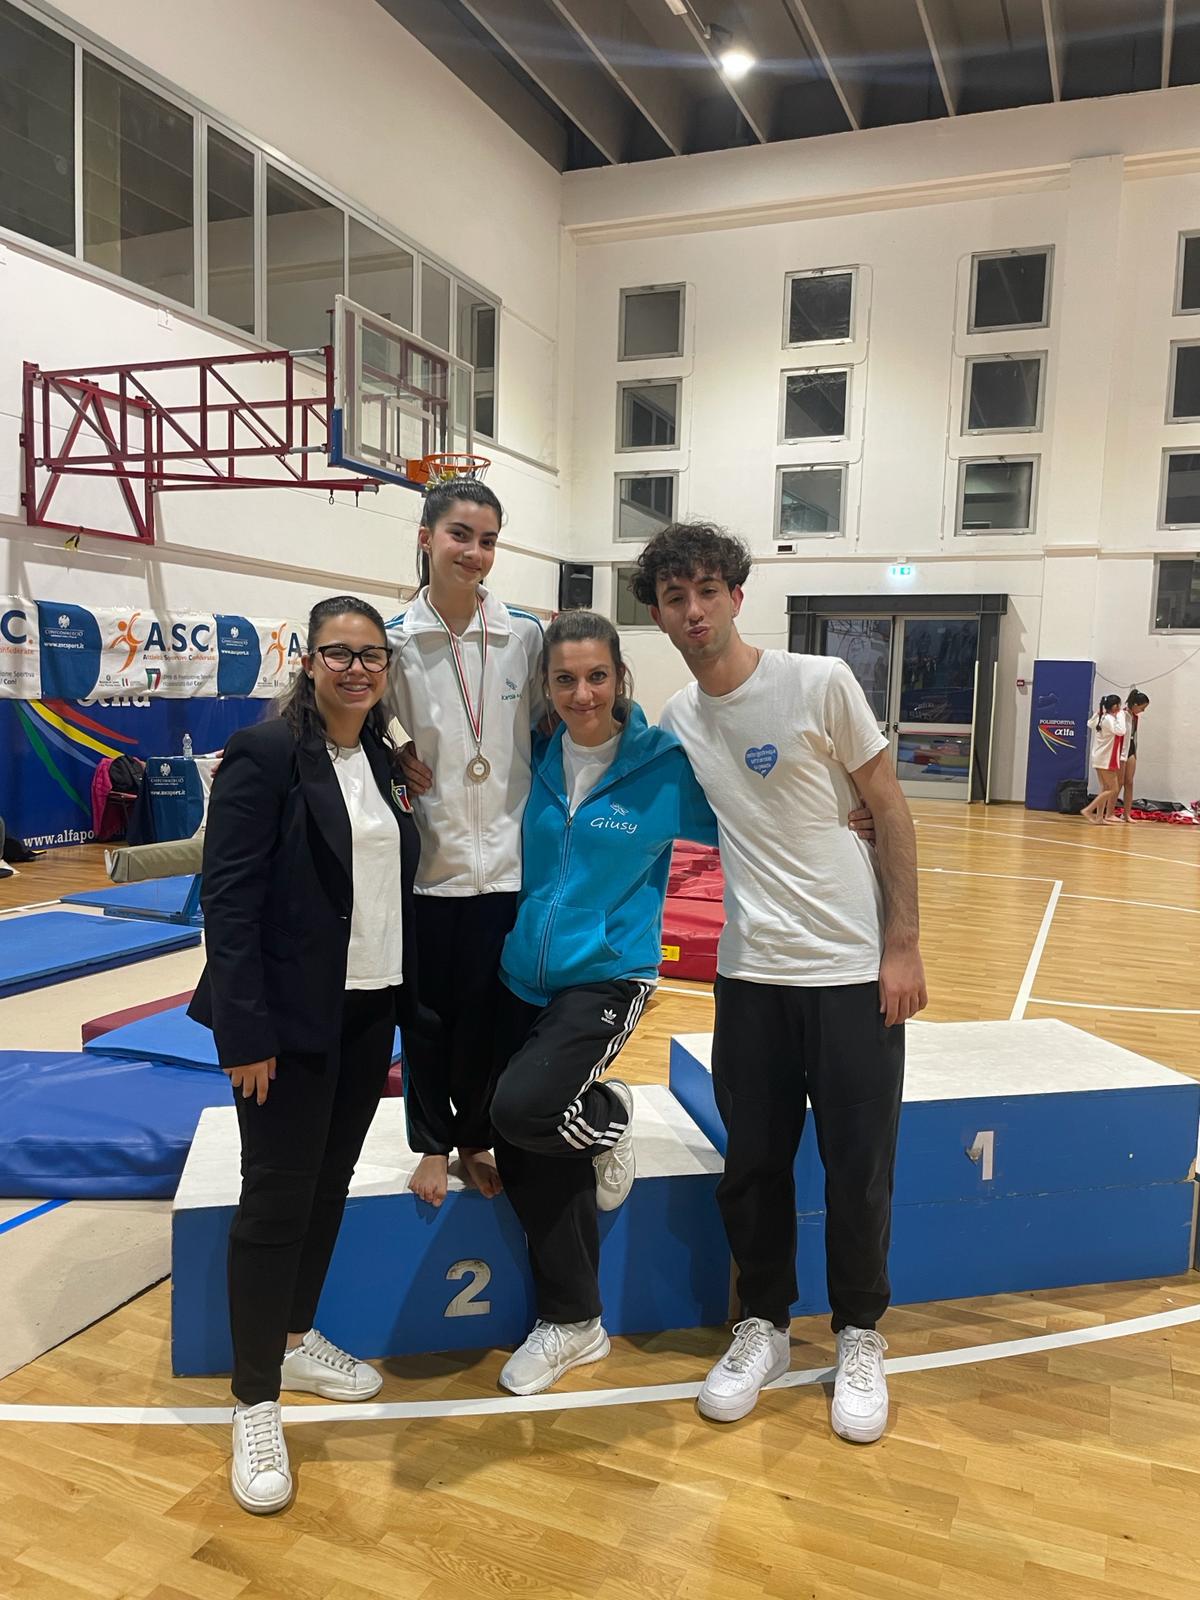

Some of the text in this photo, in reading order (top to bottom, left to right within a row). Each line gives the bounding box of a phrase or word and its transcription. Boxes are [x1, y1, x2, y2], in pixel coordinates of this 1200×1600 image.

[144, 622, 214, 652] A.S.C.
[590, 817, 638, 834] Giusy
[966, 1130, 994, 1181] 1
[444, 1260, 491, 1318] 2
